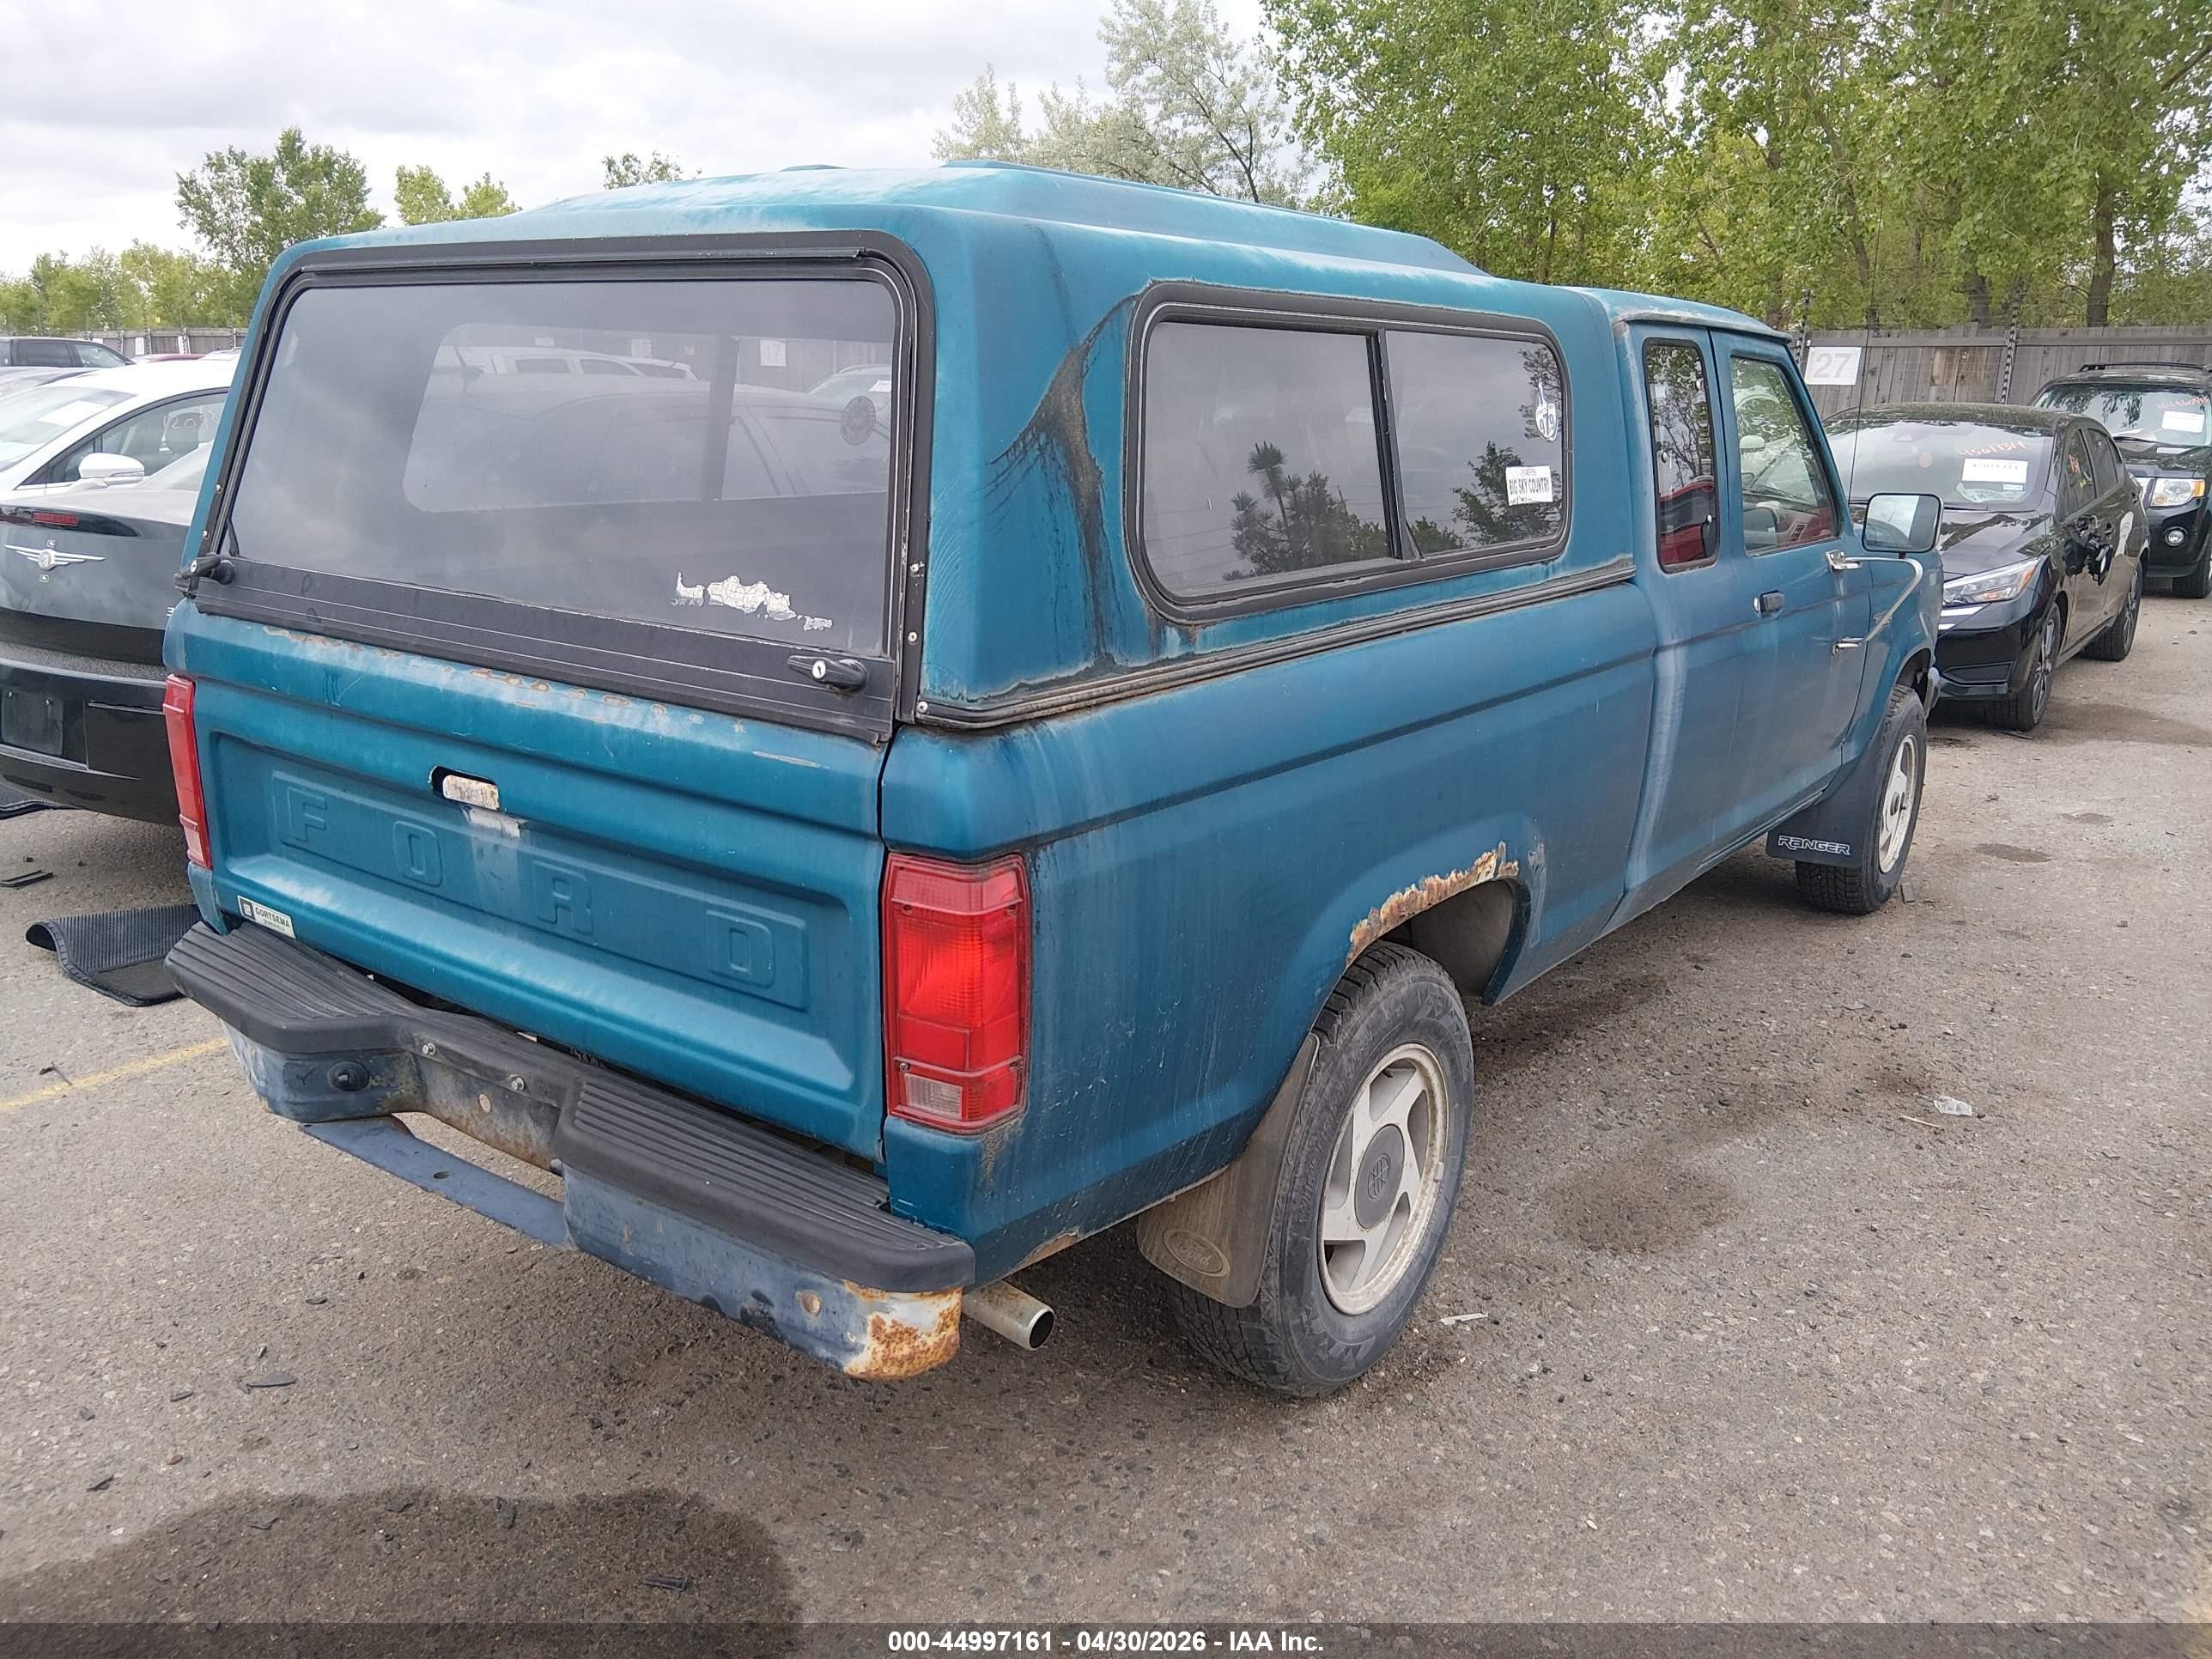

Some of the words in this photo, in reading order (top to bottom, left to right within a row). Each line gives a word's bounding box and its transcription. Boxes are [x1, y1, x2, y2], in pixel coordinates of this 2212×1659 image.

[1813, 352, 1853, 379] 27
[1508, 478, 1518, 495] BIG
[1518, 477, 1528, 495] SKY
[1528, 477, 1550, 494] COUNTRY
[1778, 835, 1851, 855] RANGER
[285, 785, 776, 990] FORD
[255, 906, 290, 928] GORTSEMA
